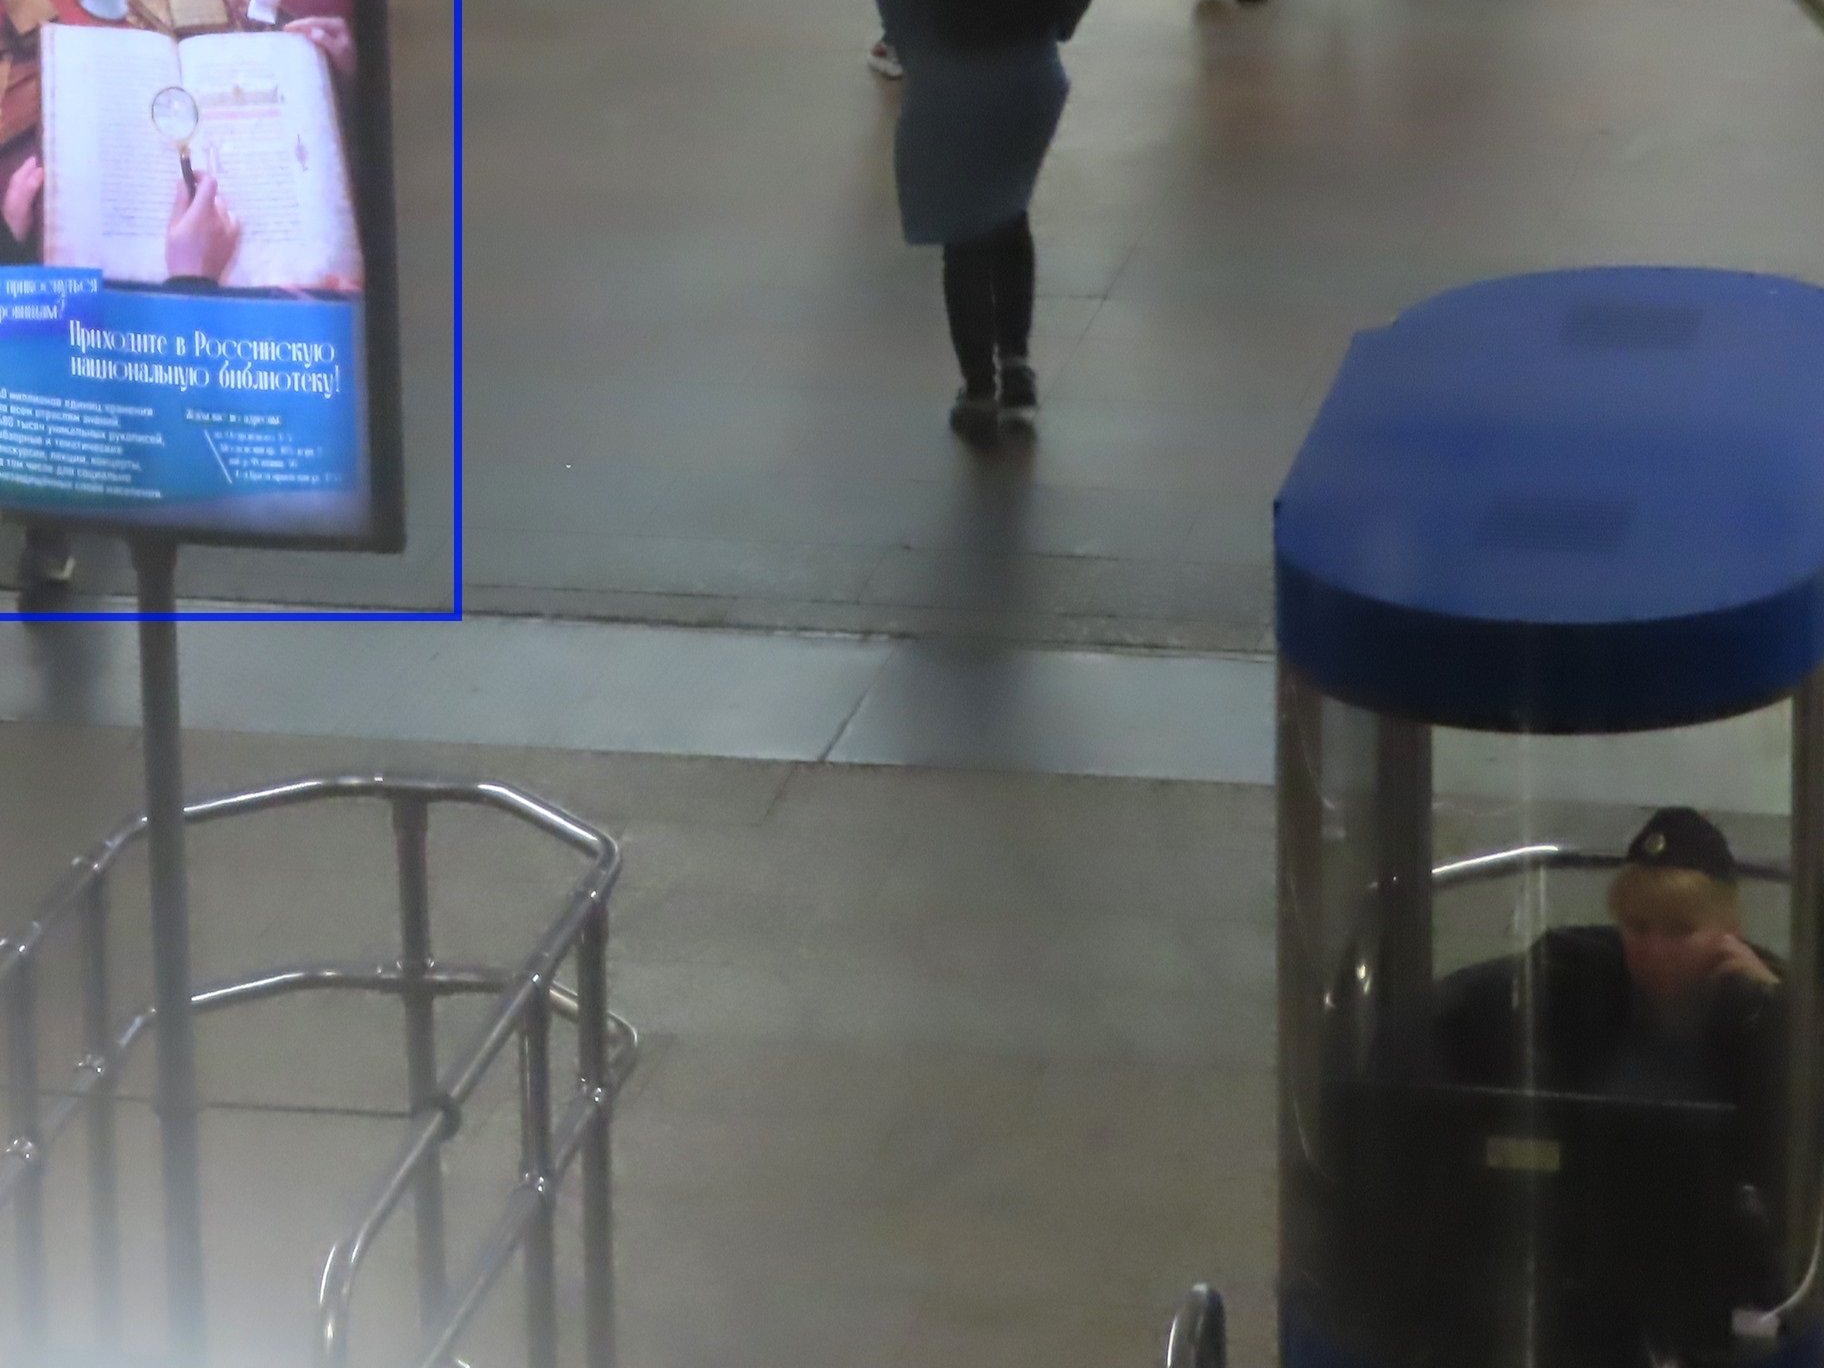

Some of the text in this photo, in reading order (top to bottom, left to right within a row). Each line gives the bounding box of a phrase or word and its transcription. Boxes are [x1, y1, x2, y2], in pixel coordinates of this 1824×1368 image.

[69, 319, 336, 369] Приходите в Российскую
[71, 355, 341, 399] национальную библиотеку!
